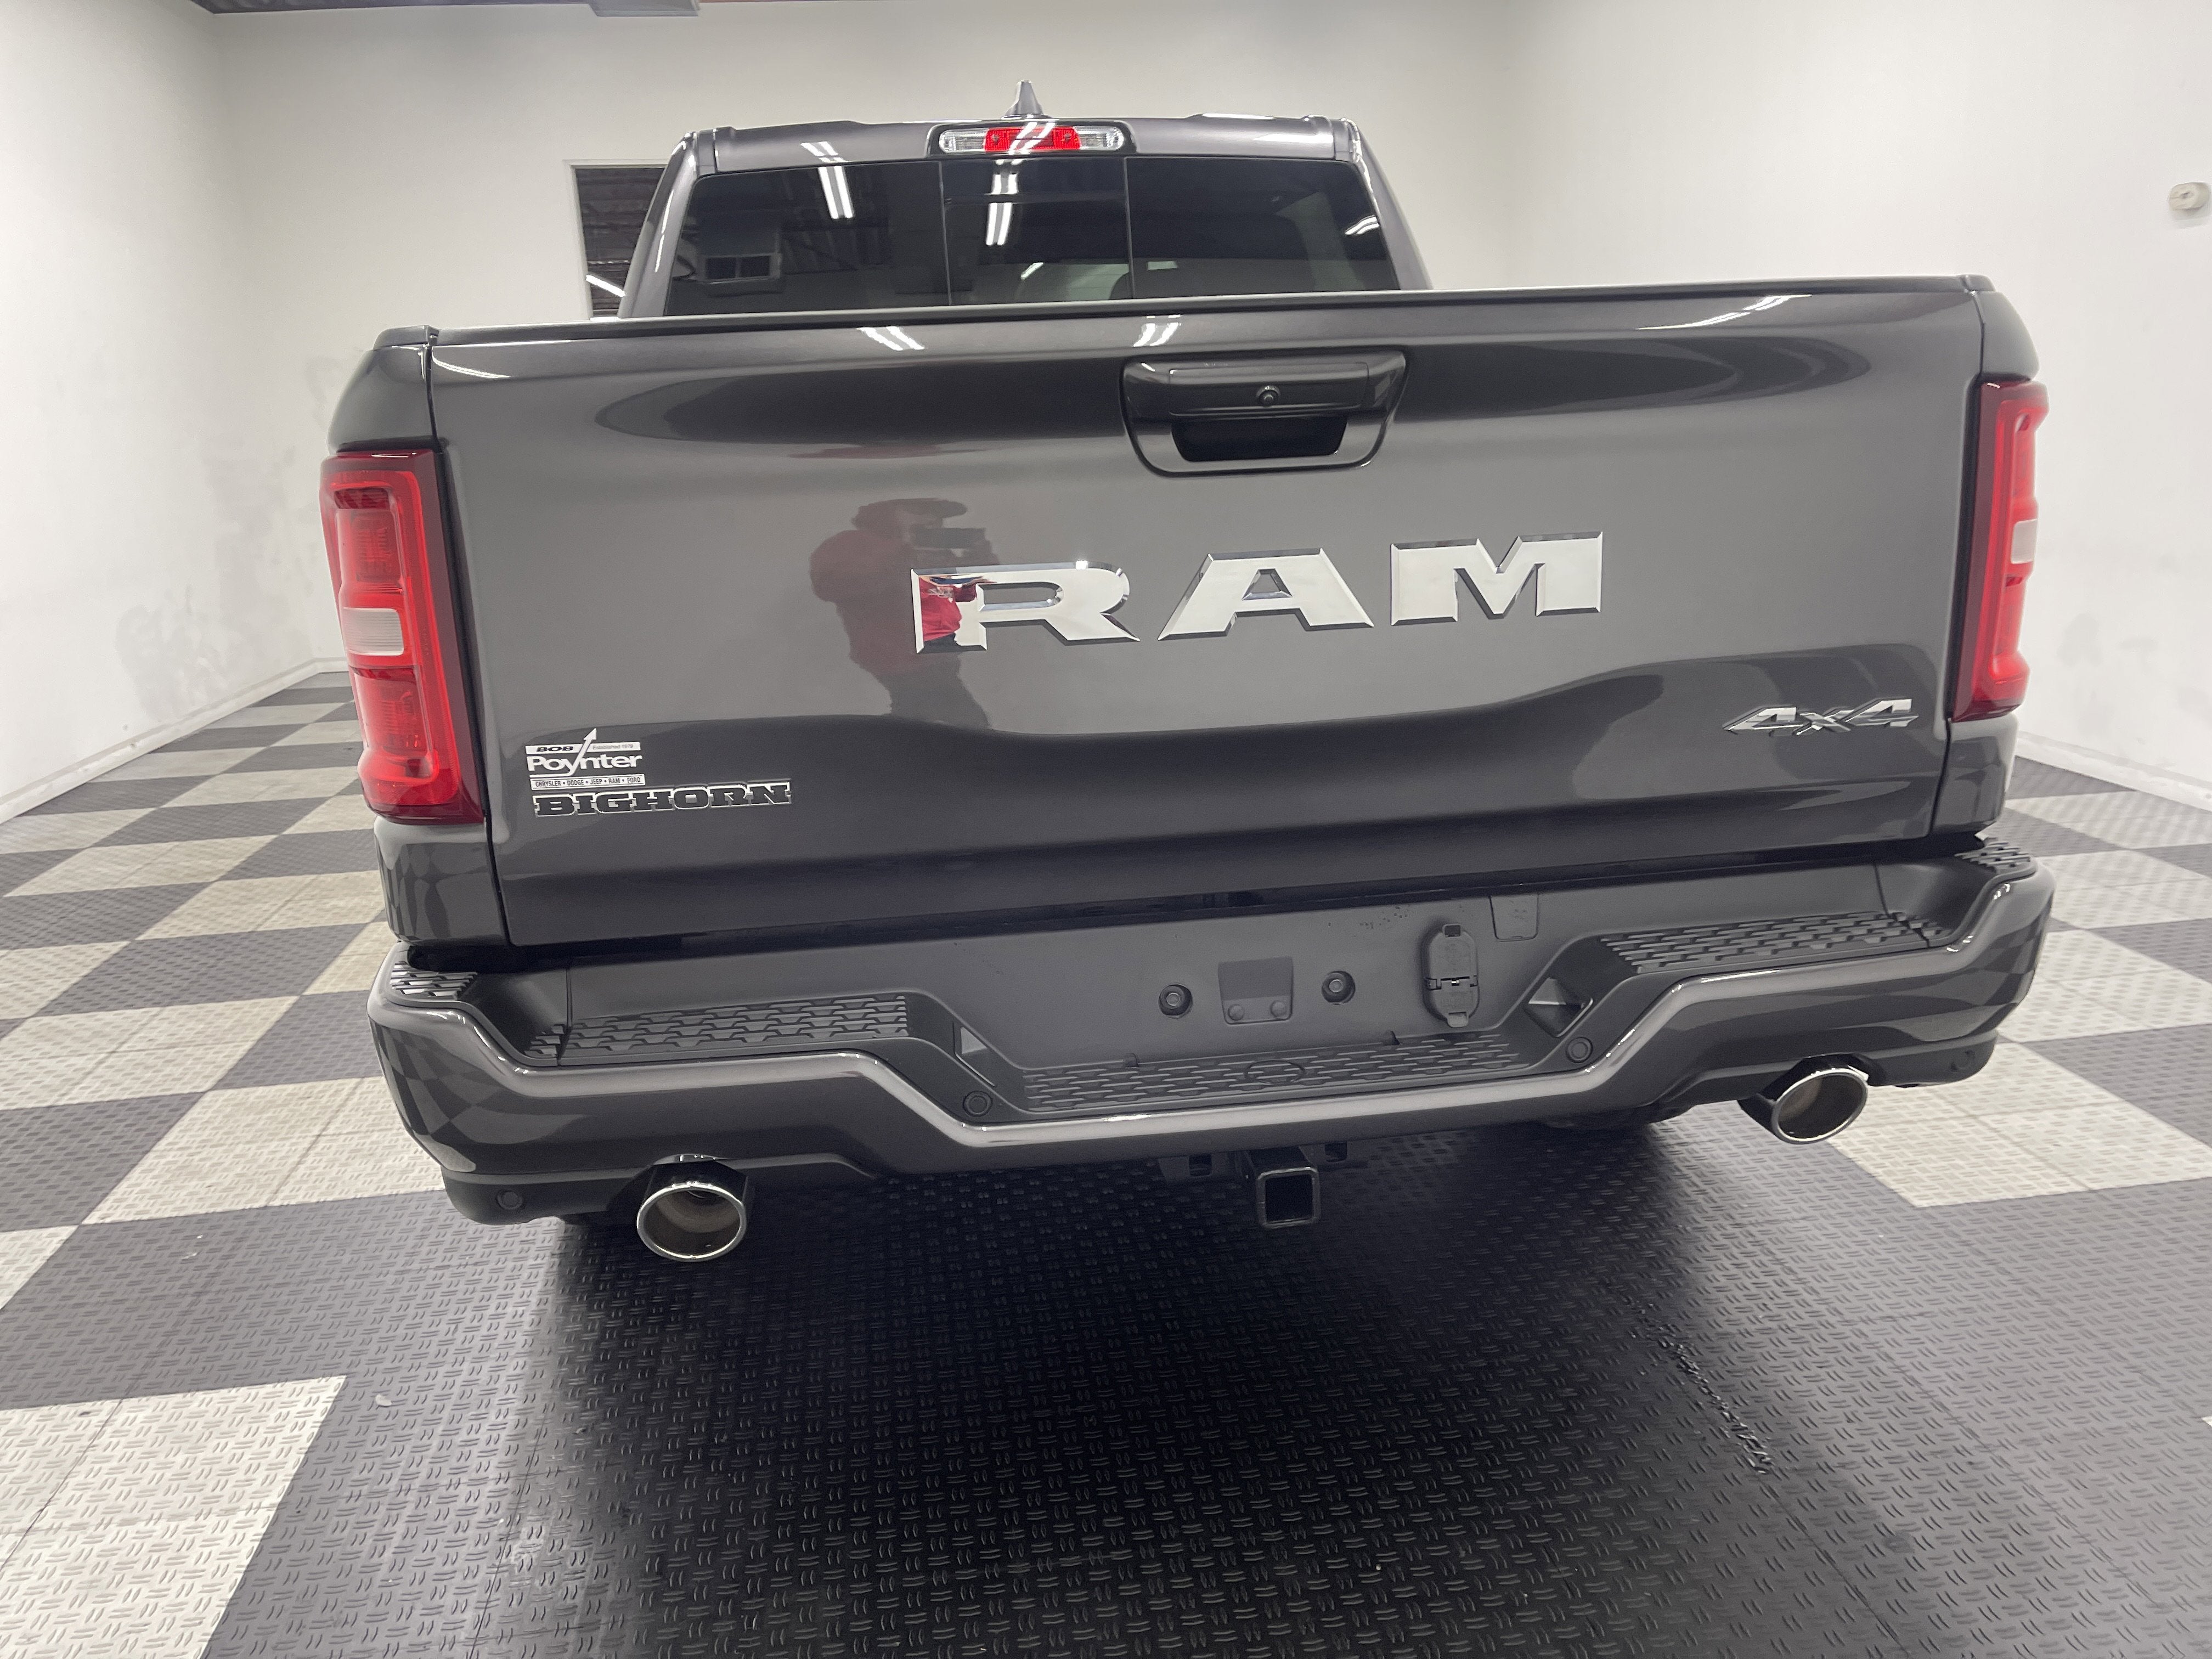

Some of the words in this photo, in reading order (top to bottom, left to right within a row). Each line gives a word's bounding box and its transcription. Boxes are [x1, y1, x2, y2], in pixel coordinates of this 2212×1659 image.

[911, 531, 1604, 653] RAM
[526, 753, 642, 776] Poynter
[532, 782, 792, 817] BIGHORN
